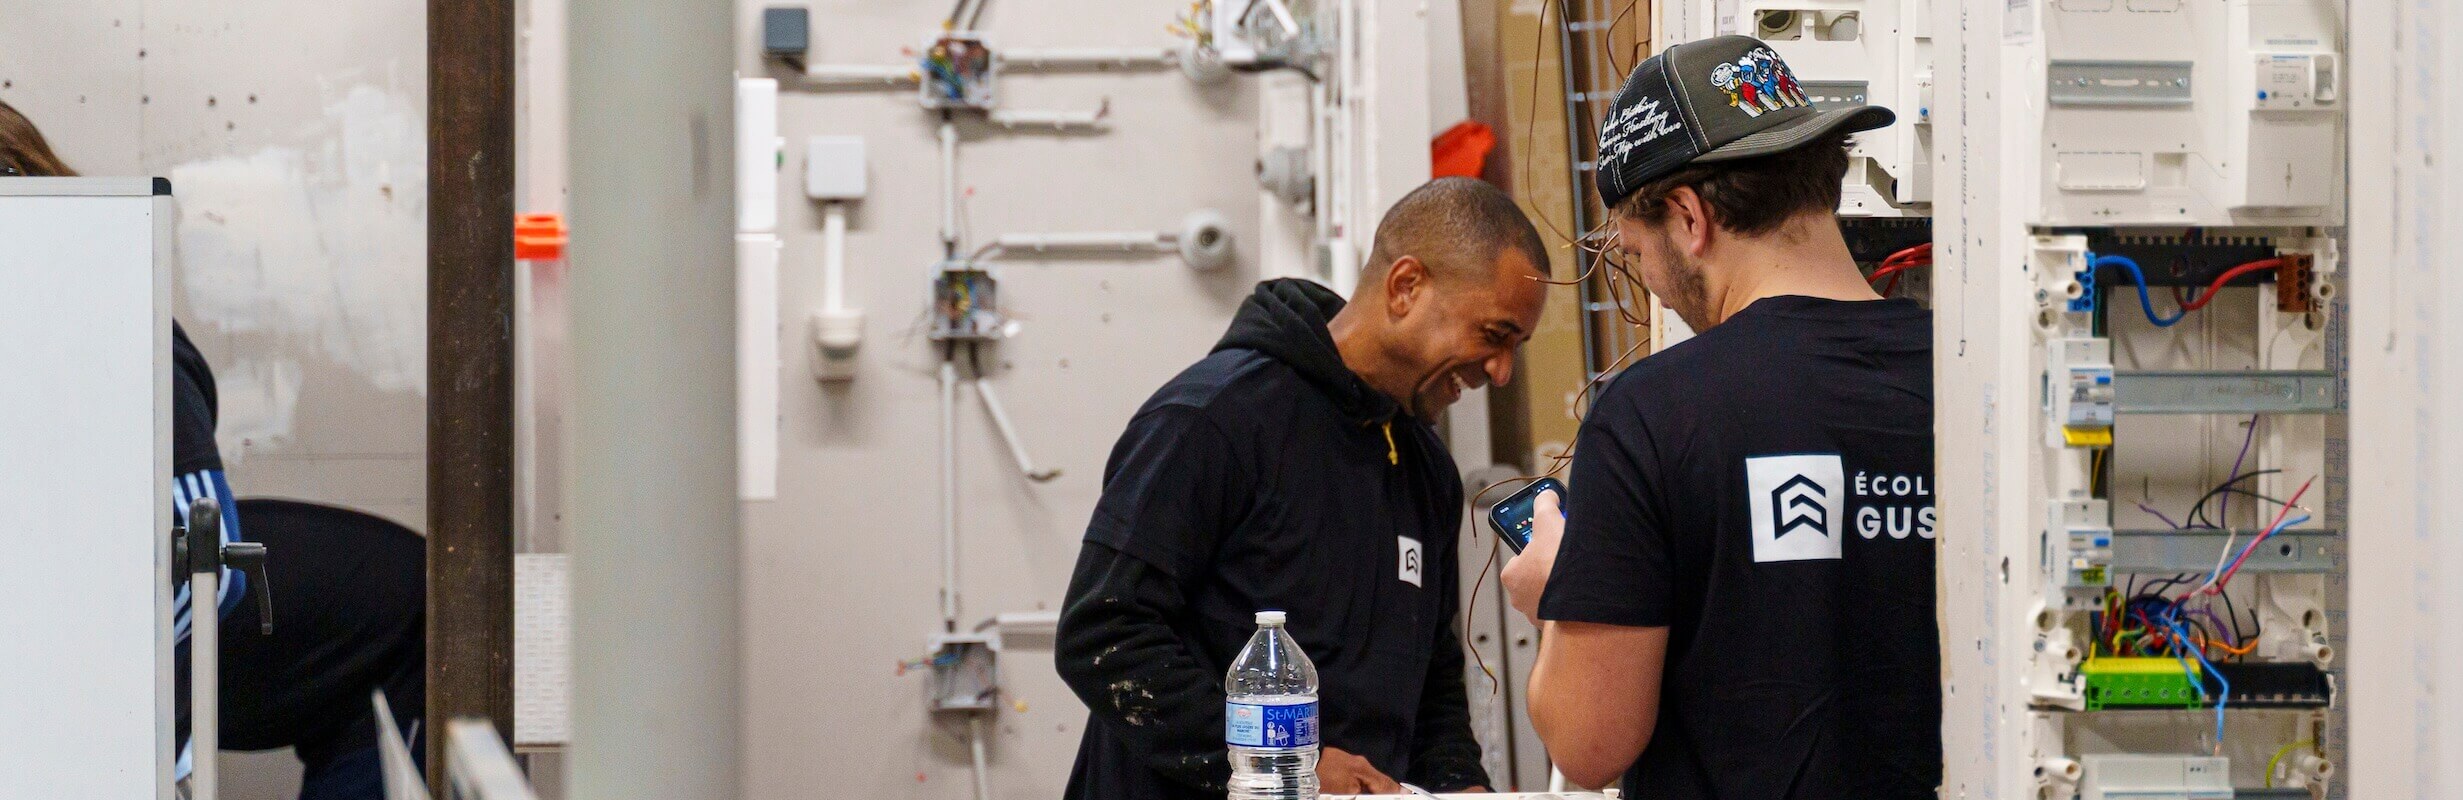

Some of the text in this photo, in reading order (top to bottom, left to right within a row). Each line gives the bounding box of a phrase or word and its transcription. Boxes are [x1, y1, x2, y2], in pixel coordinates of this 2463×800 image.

[1634, 121, 1659, 146] with
[1658, 120, 1681, 136] love
[1855, 471, 1929, 496] ÉCOL
[1857, 507, 1936, 539] GUS
